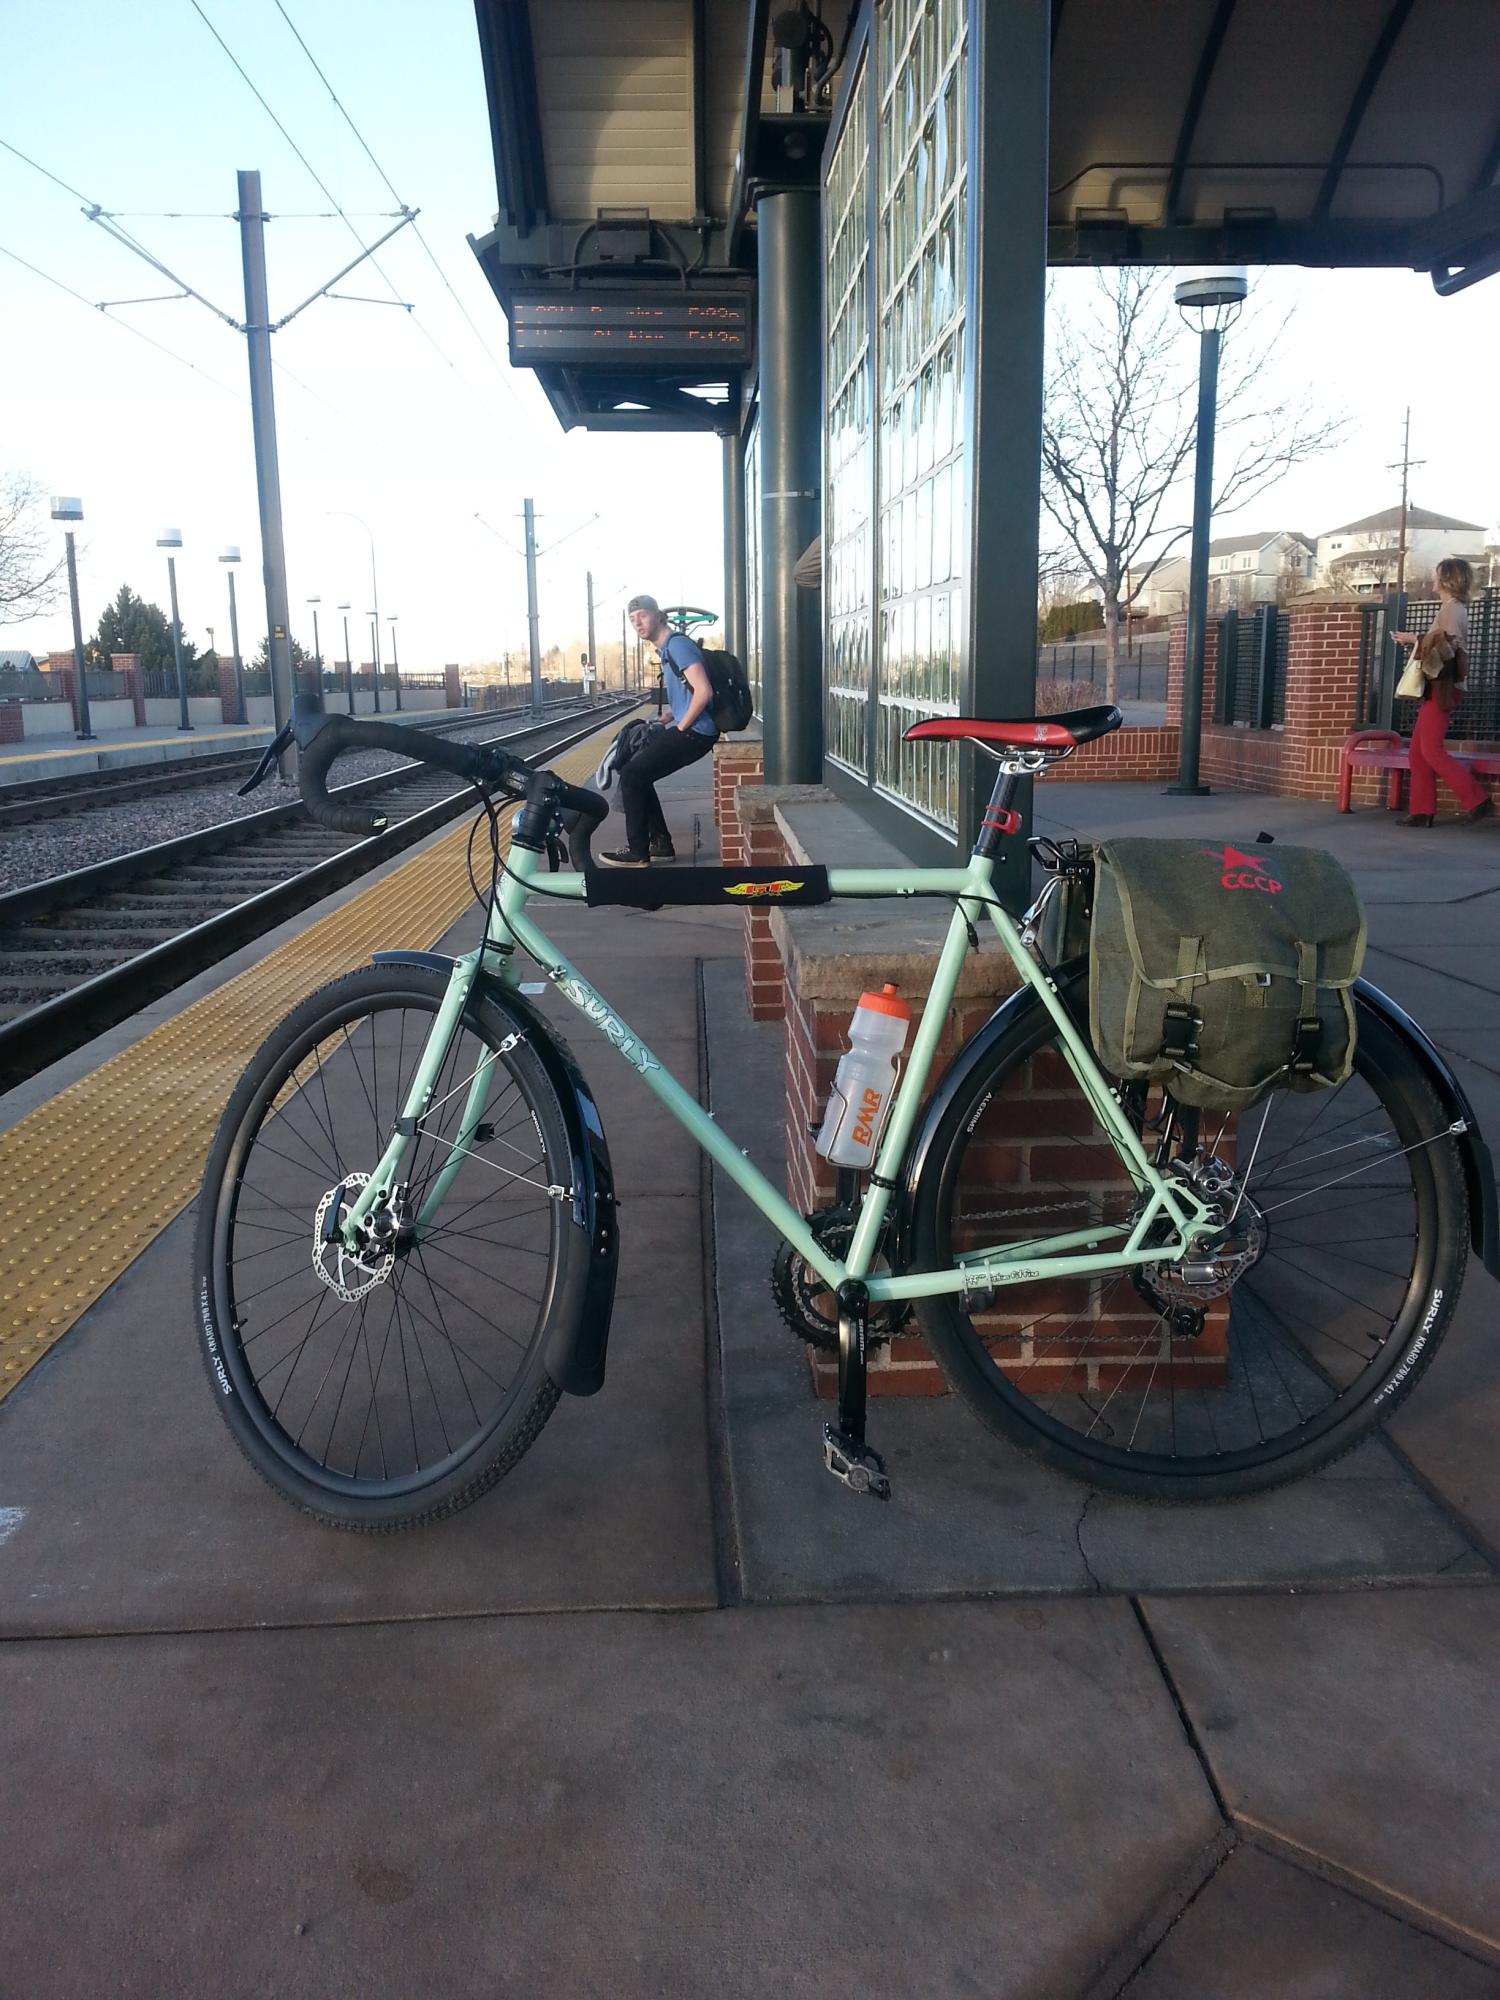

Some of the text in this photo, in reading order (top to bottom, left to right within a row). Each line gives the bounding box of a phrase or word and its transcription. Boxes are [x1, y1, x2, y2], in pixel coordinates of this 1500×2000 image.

[1221, 873, 1283, 896] CCCP
[562, 977, 661, 1074] SURLY
[851, 1087, 882, 1147] RMR
[1422, 1288, 1444, 1334] SURLY
[1406, 1335, 1427, 1365] KNARD
[212, 1355, 233, 1395] SURLY
